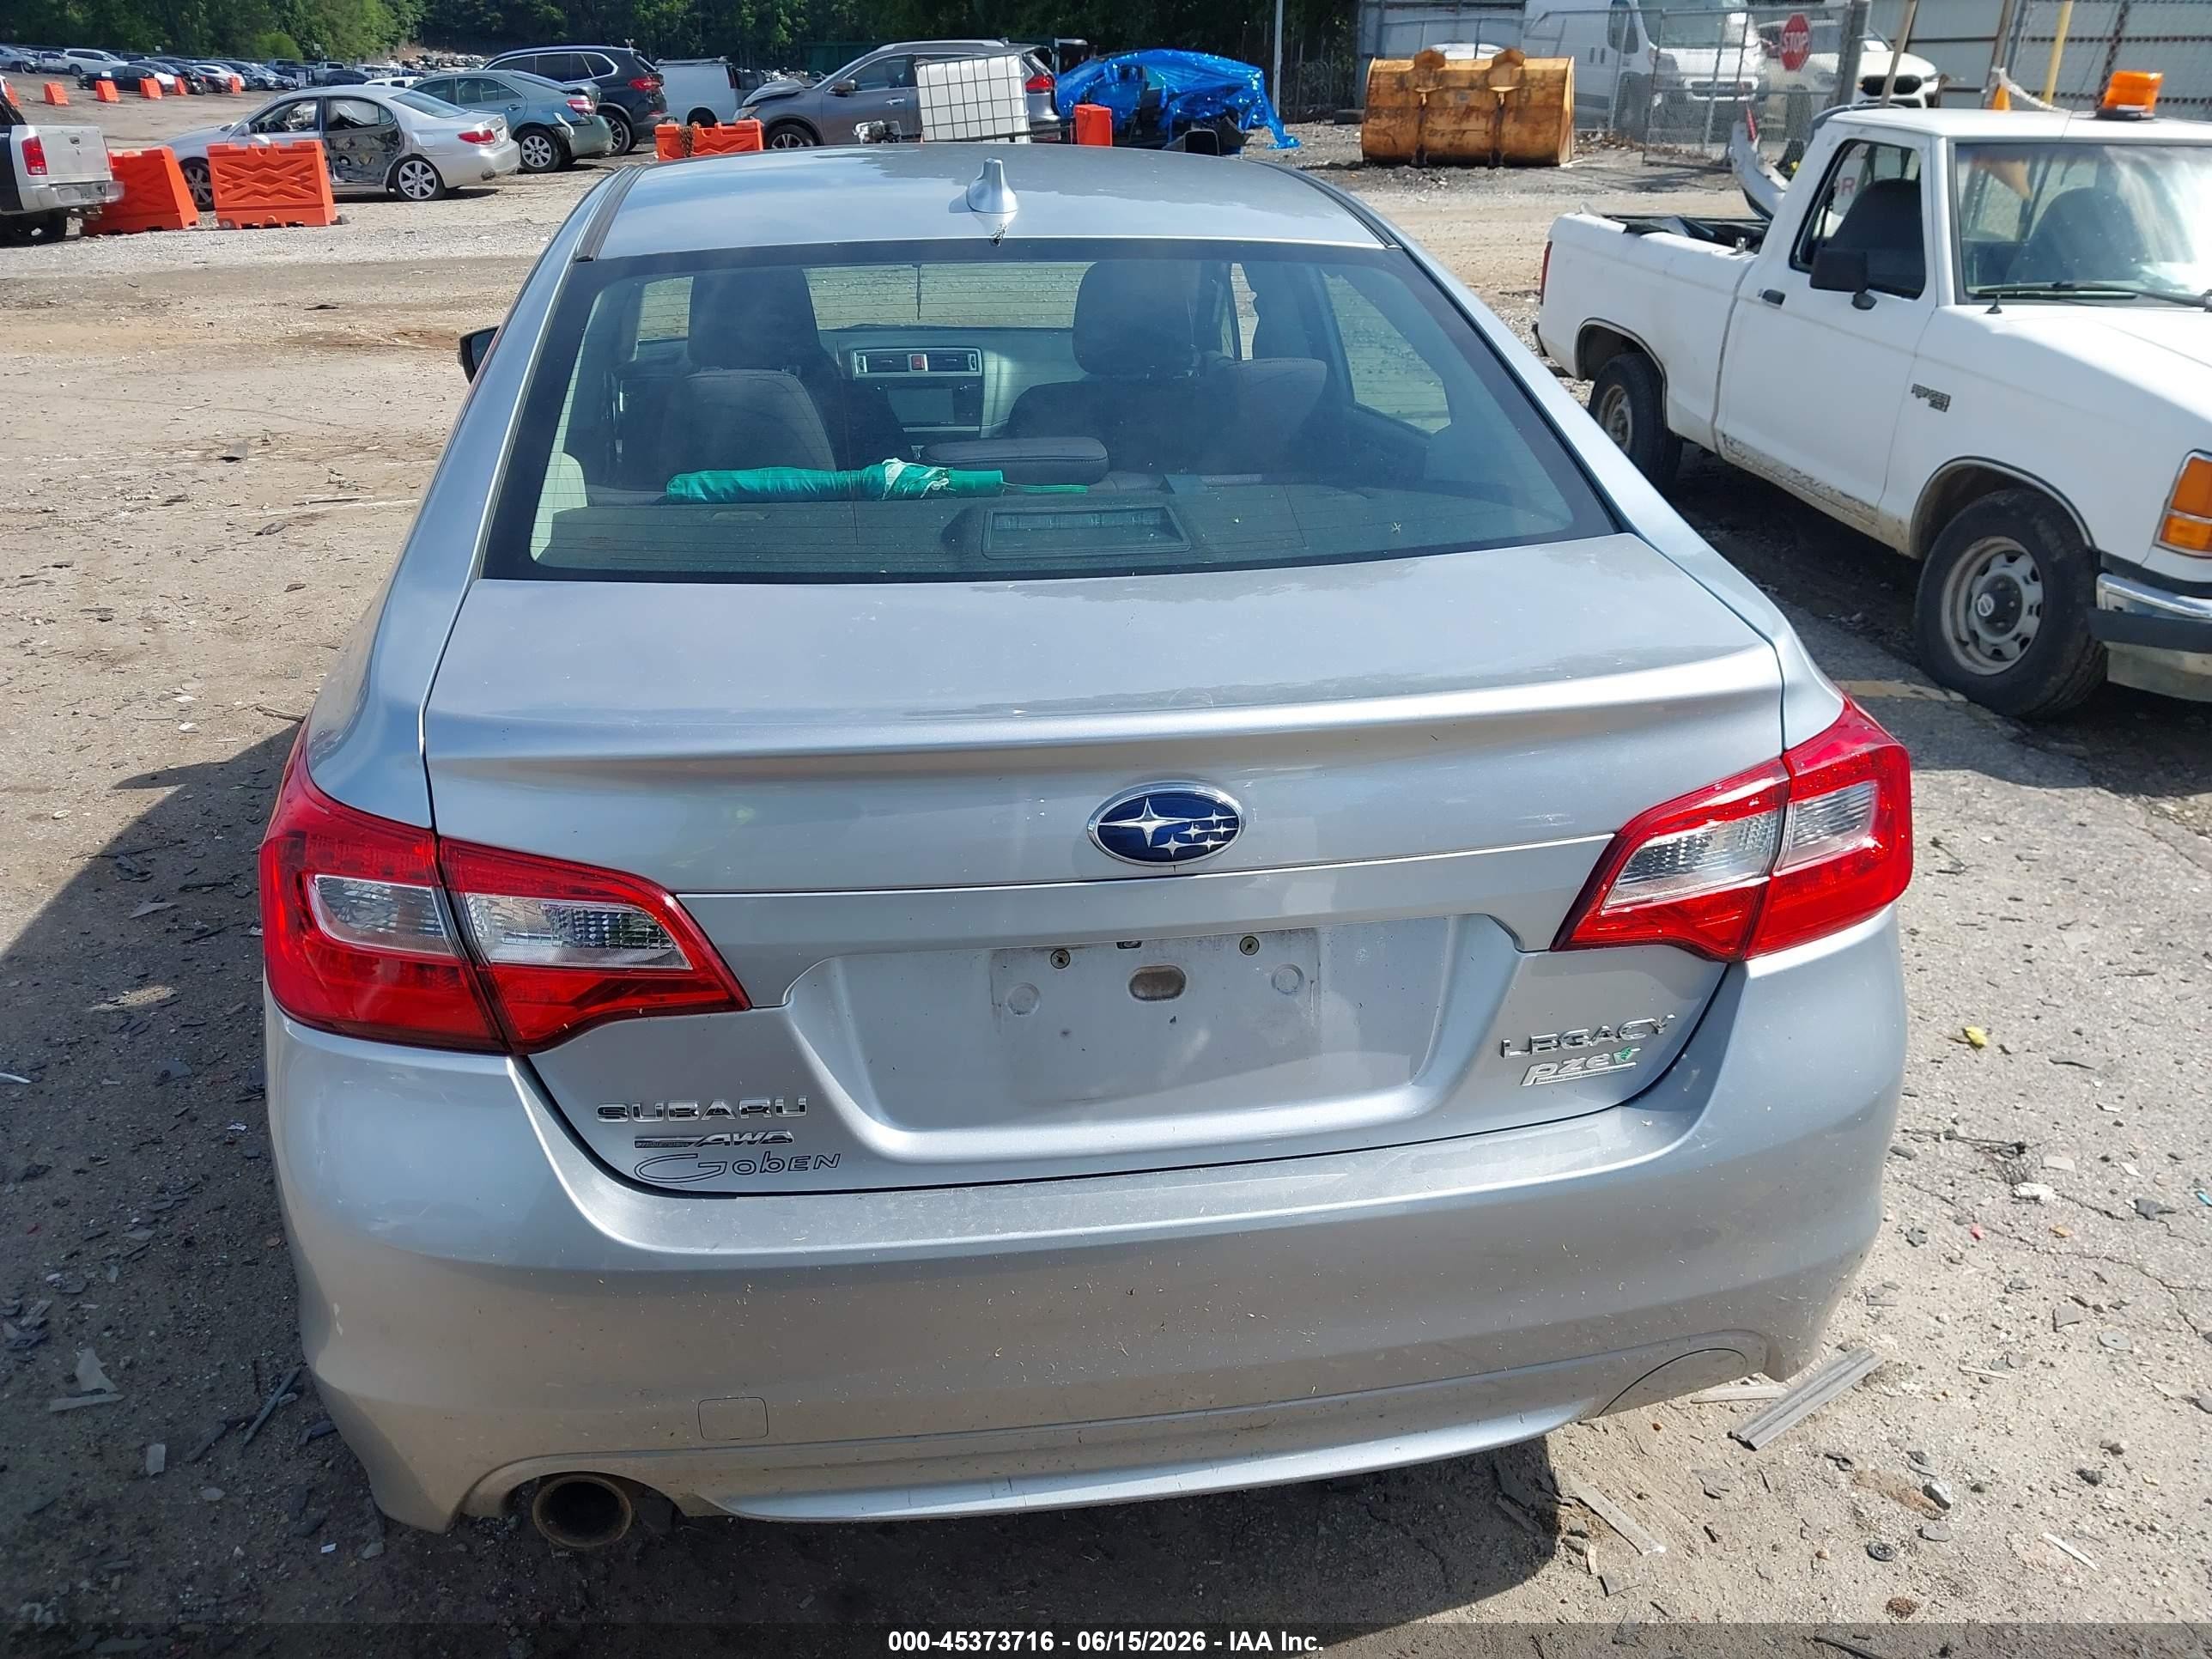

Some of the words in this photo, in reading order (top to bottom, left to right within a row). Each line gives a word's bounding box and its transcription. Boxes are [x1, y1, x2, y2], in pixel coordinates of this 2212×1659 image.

[1782, 31, 1808, 54] STOP
[1500, 1013, 1675, 1059] LEGACY
[596, 1096, 807, 1122] SUBARU
[694, 1130, 794, 1148] AWD
